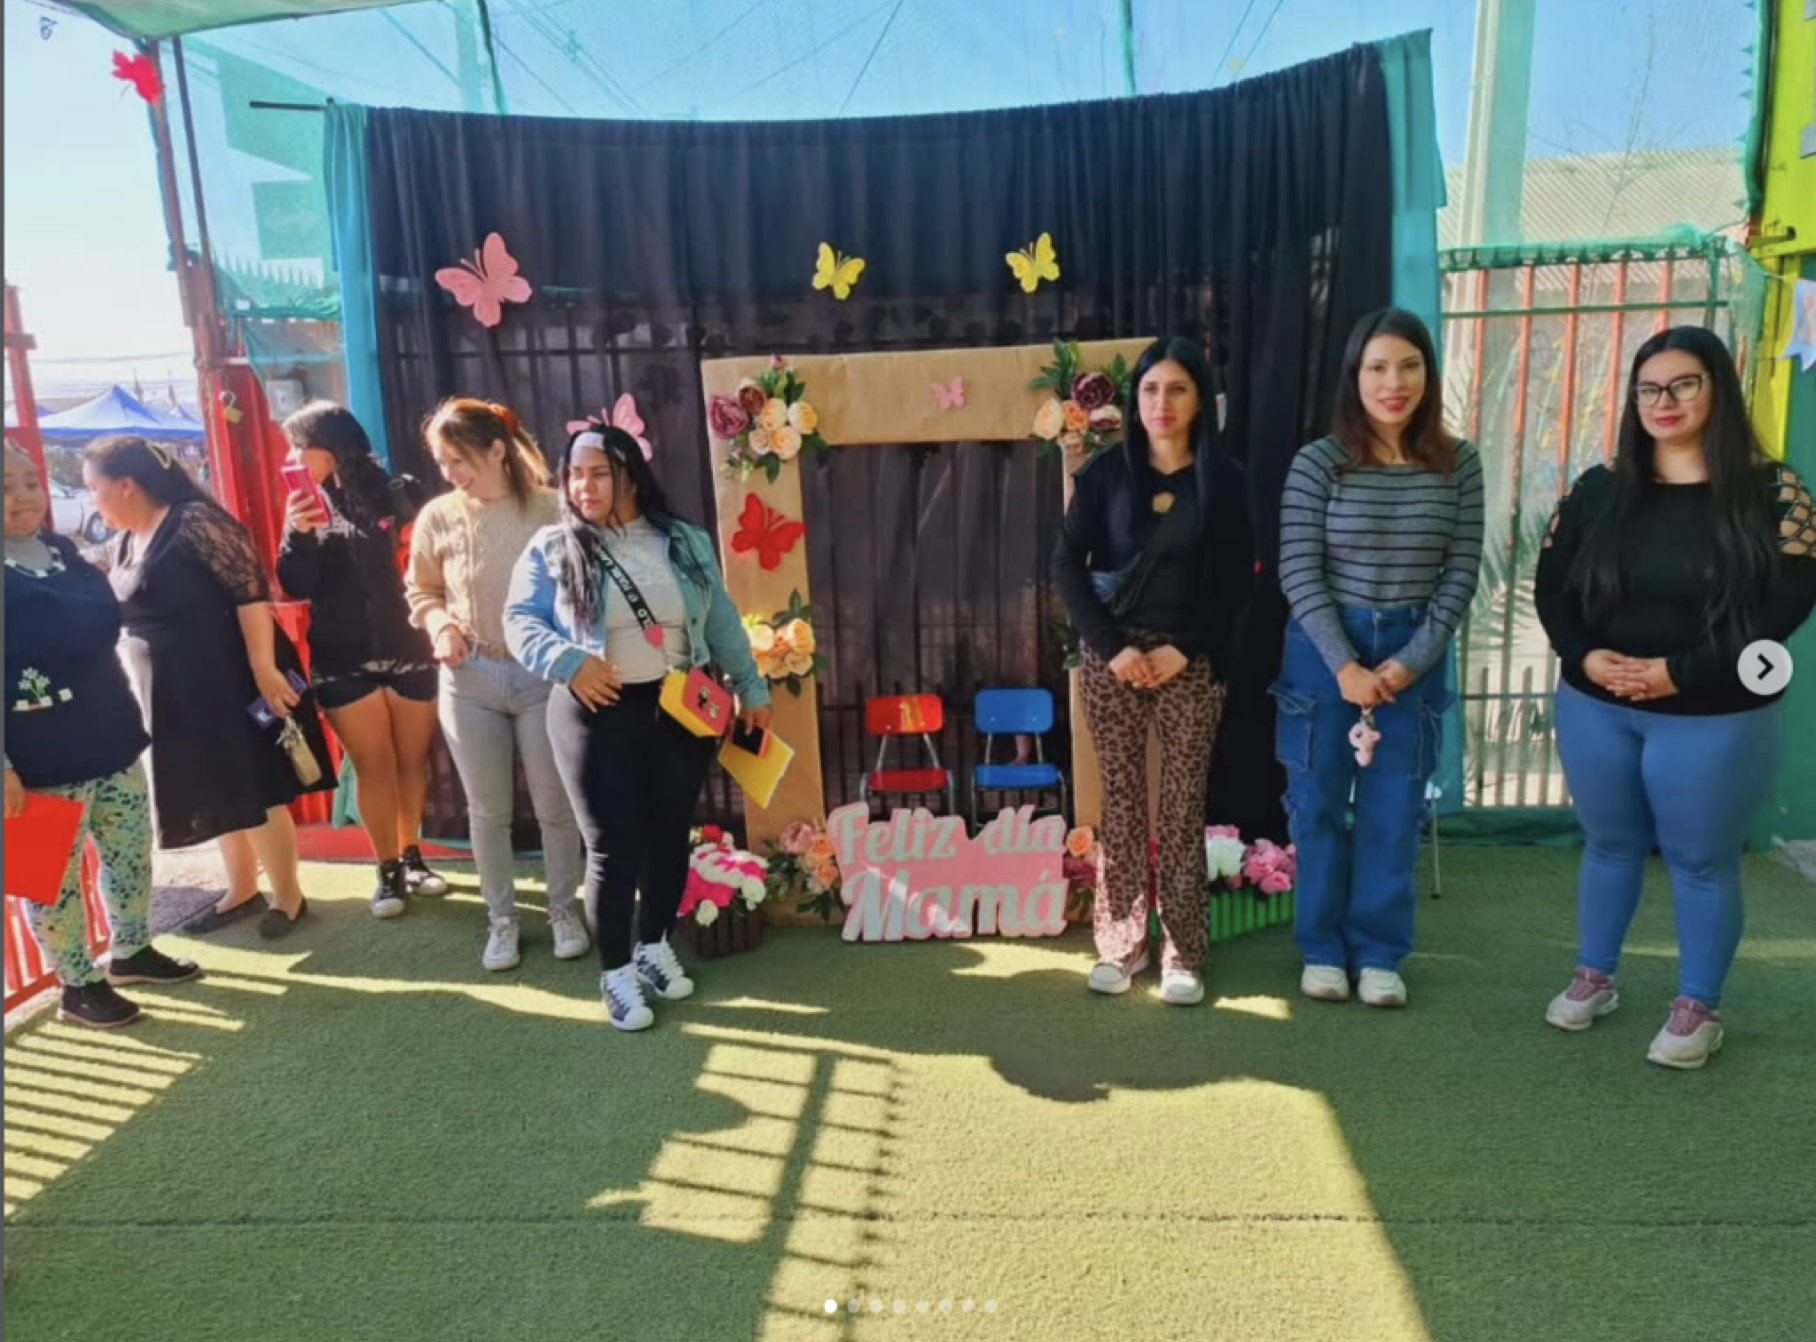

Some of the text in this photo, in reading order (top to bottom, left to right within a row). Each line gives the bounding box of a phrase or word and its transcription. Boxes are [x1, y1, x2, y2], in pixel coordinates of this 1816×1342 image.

[831, 805, 1063, 866] Feliz día
[845, 867, 1066, 942] Mamá
